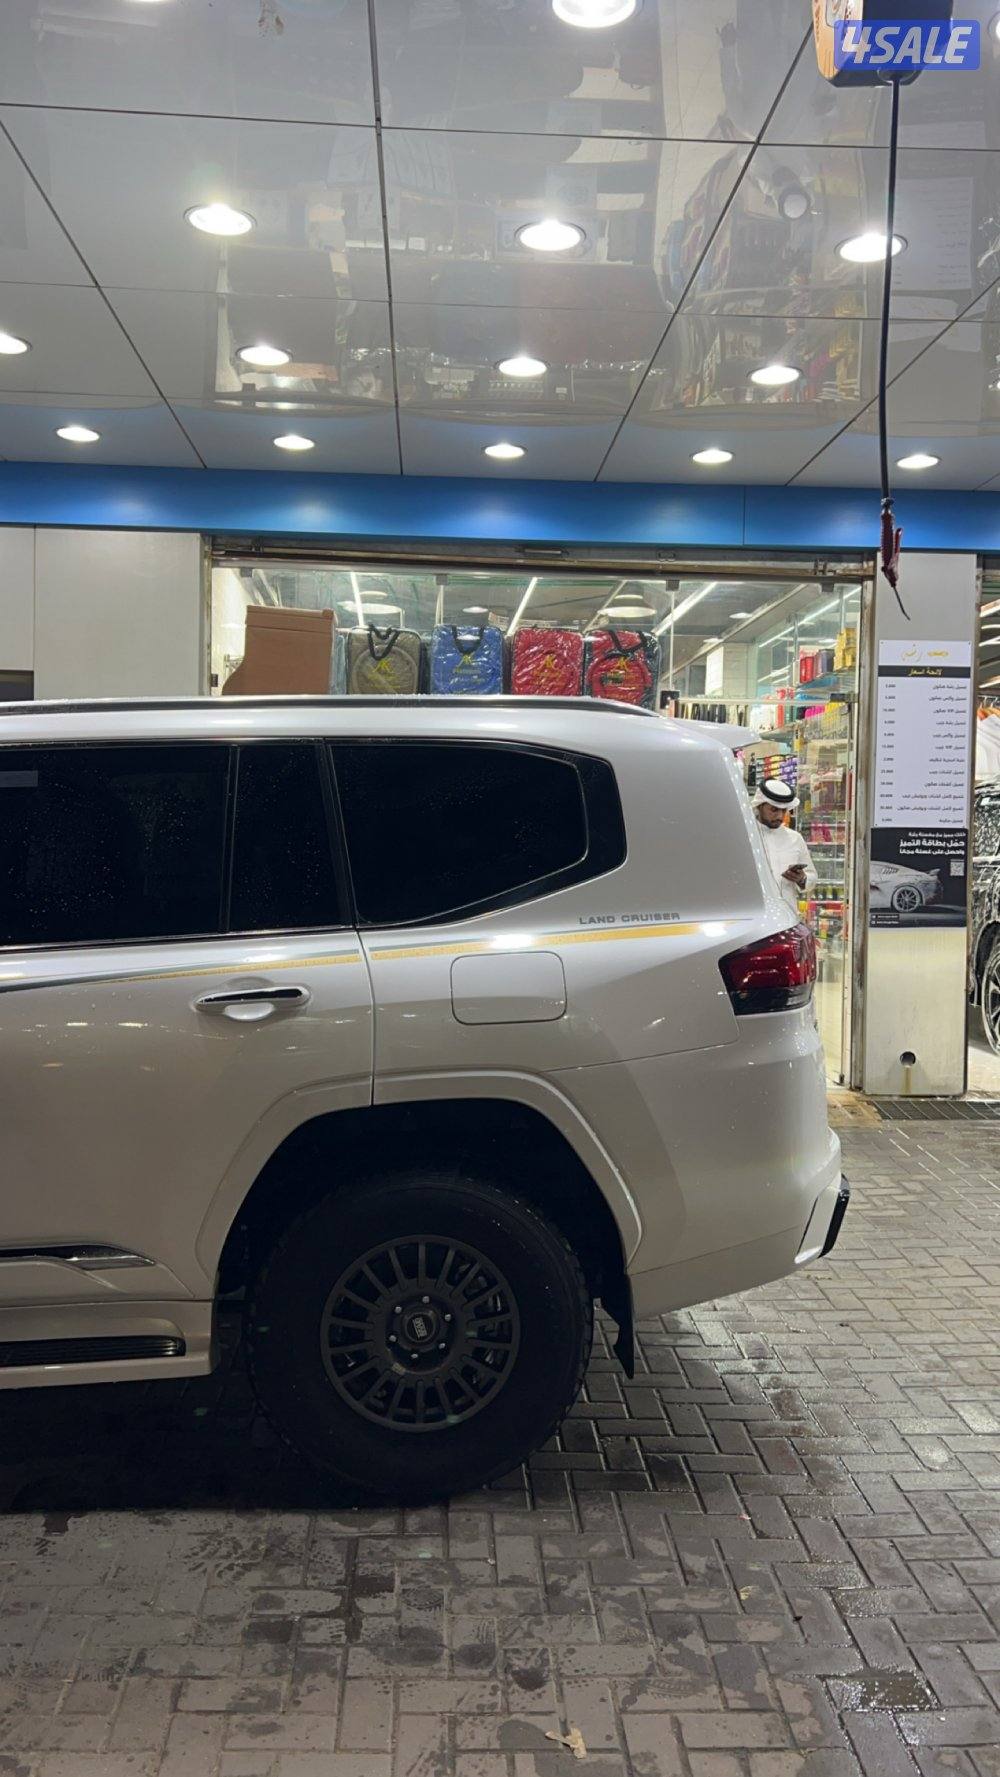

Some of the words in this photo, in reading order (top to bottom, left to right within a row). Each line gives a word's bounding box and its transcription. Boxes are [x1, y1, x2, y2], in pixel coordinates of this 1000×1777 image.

[899, 838, 921, 847] التميز
[922, 838, 946, 847] بطاقة
[579, 915, 615, 925] LAND
[621, 912, 681, 923] CRUISER
